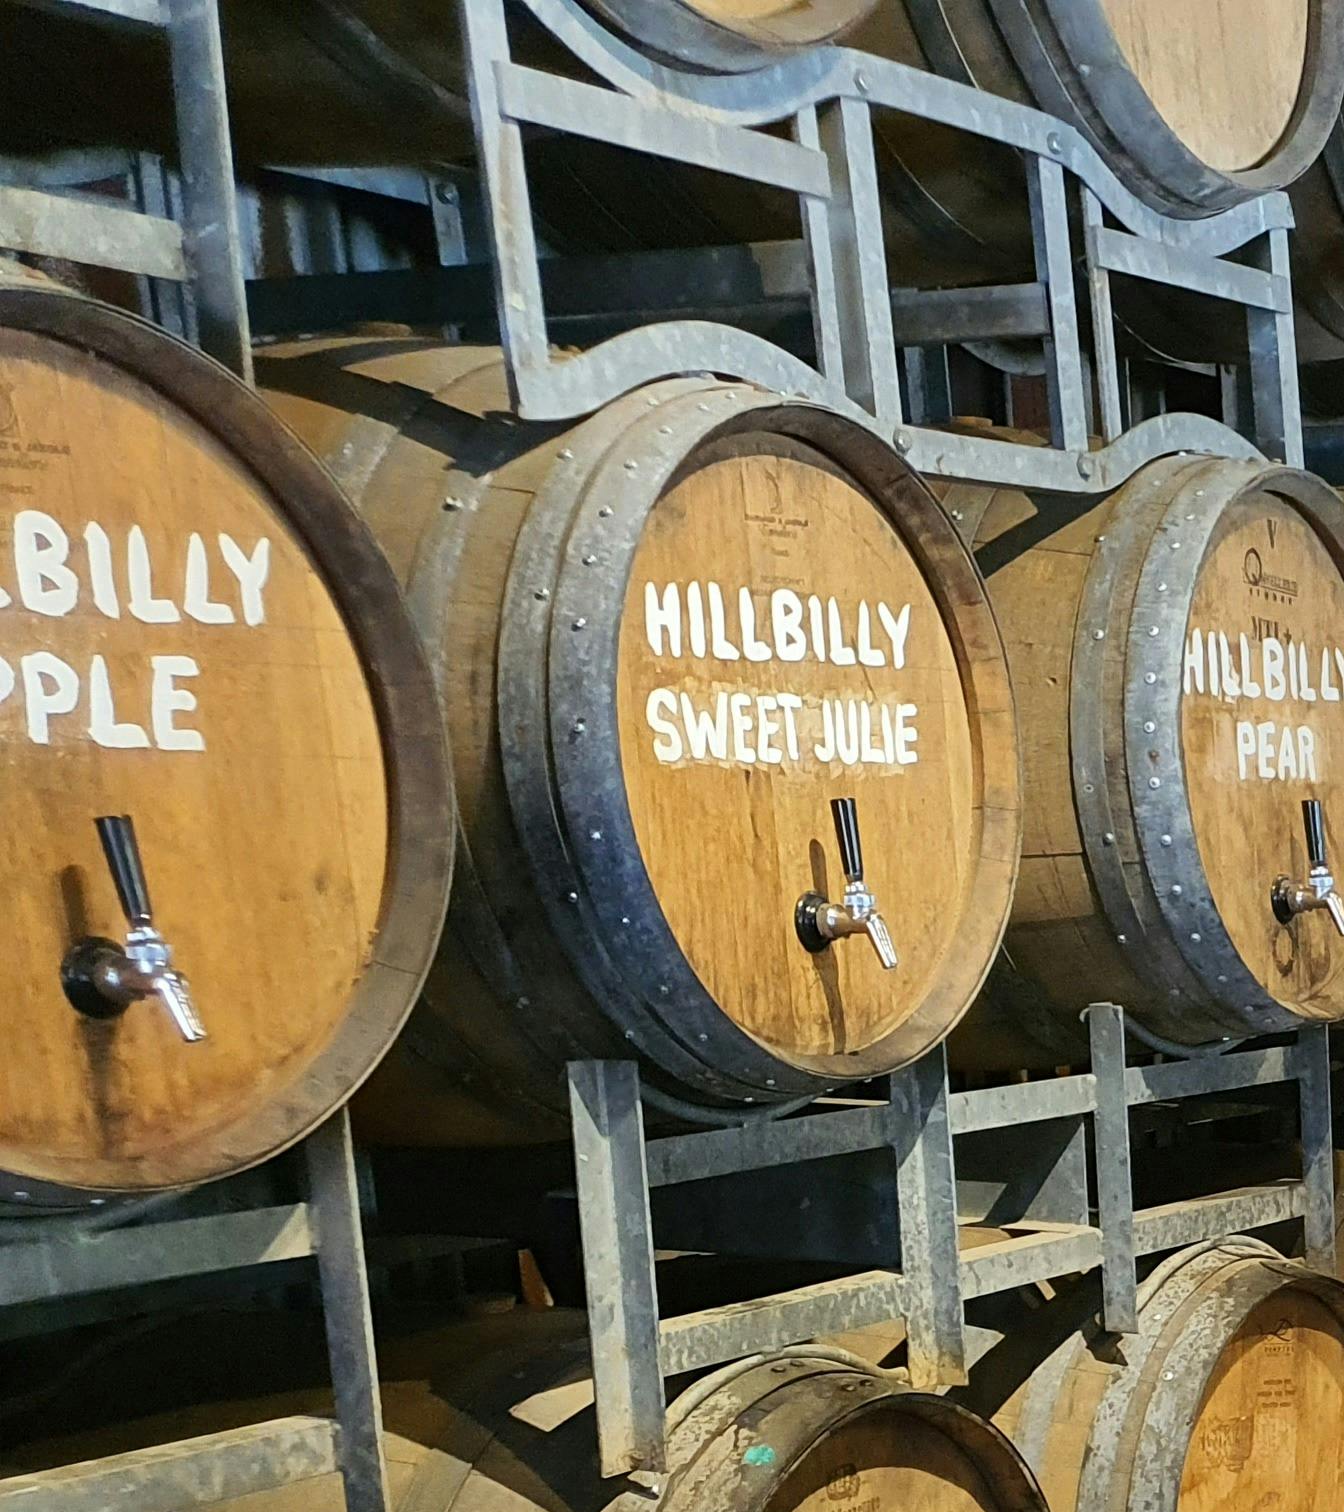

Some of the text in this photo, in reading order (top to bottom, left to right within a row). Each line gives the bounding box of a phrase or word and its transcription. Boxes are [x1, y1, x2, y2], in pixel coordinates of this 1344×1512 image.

[0, 510, 270, 627] BILLY
[644, 580, 911, 670] HILLBILLY
[0, 651, 206, 751] PLE
[646, 688, 918, 765] SWEET JULIE
[1236, 720, 1316, 782] PEAR
